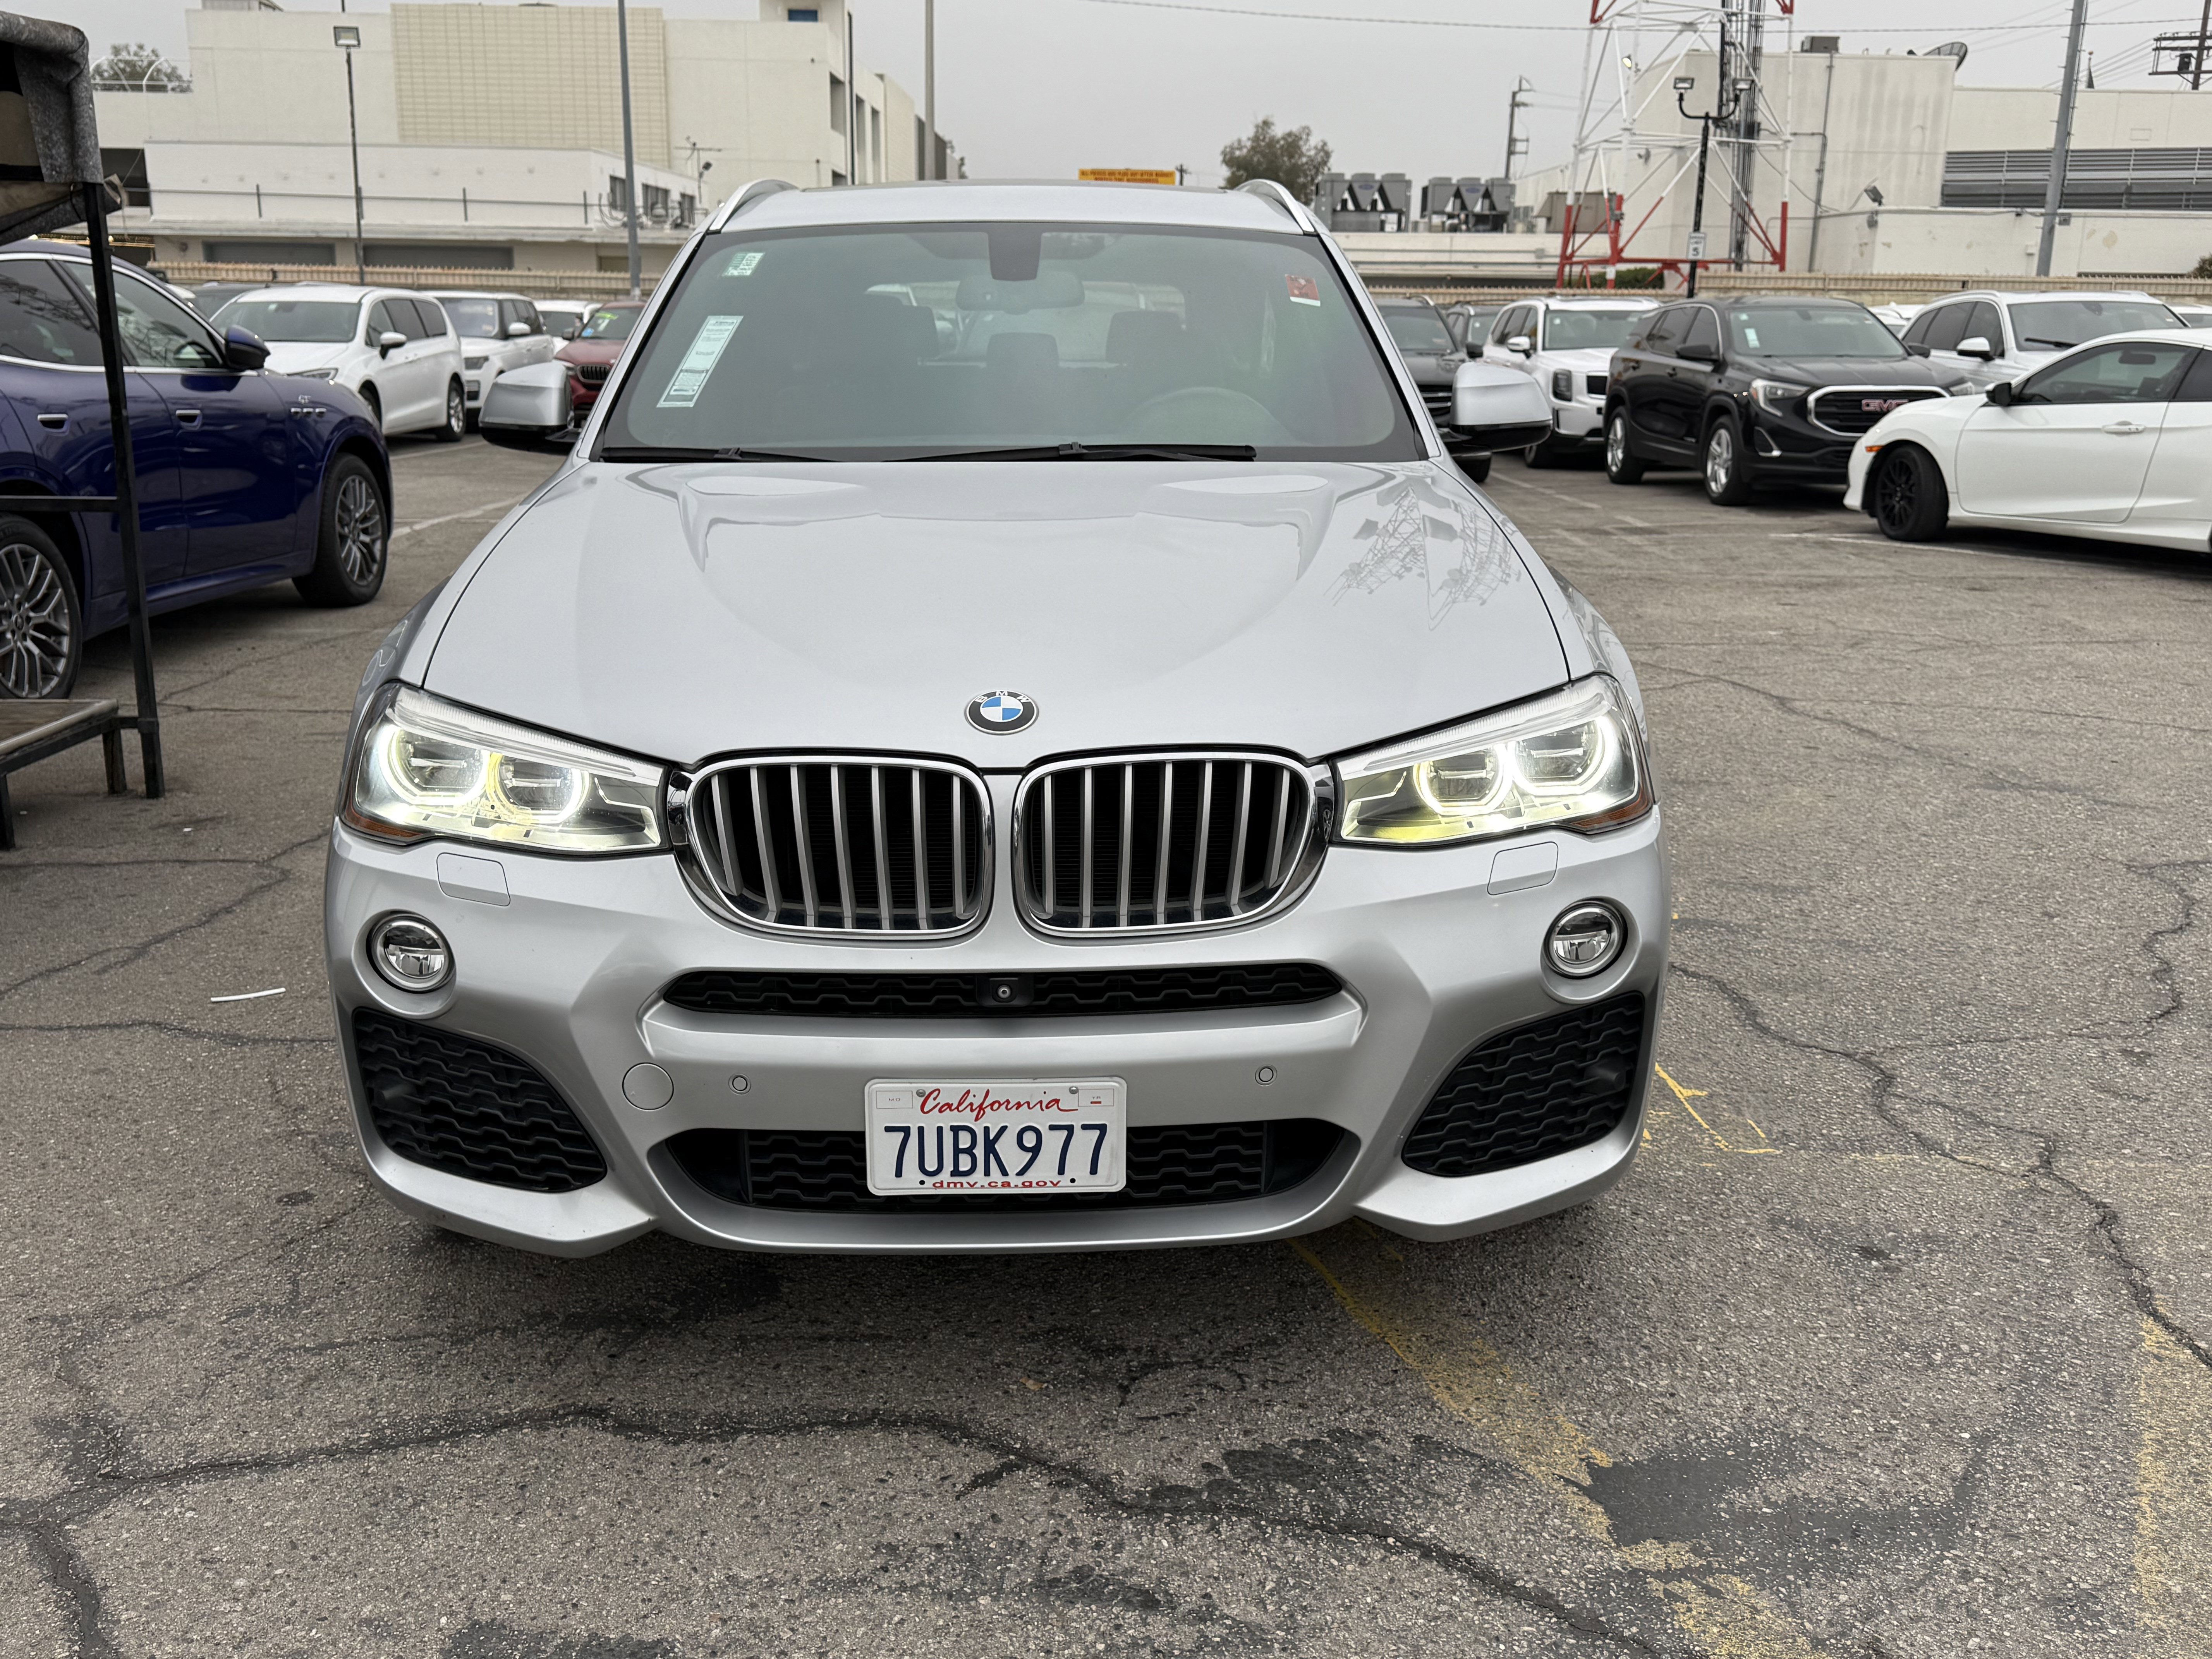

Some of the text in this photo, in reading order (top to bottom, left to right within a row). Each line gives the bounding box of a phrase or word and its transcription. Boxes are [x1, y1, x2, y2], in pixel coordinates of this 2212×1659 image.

[1692, 247, 1700, 257] 5
[975, 691, 1031, 703] BMW
[920, 1089, 1079, 1121] California
[884, 1123, 1108, 1178] 7UBK977
[932, 1179, 1061, 1188] dmv.ca.gov
